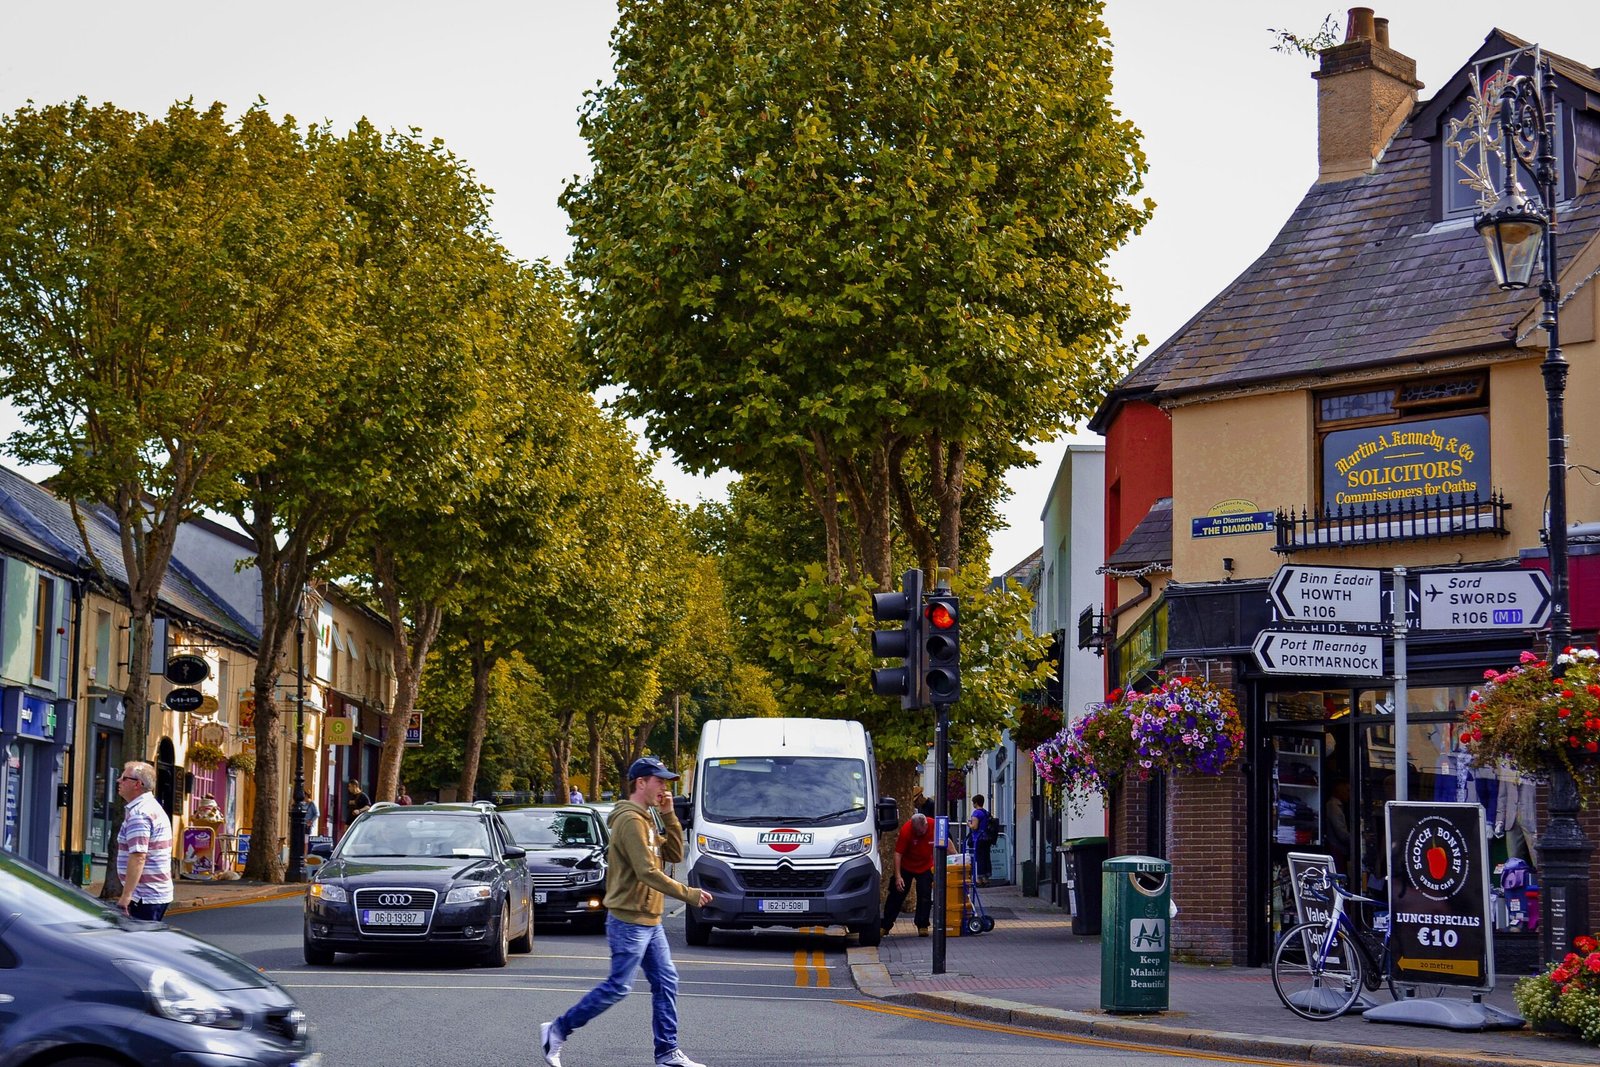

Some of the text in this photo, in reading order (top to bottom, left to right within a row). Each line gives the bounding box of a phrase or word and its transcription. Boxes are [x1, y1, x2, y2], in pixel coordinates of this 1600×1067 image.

[1335, 441, 1378, 476] Martin
[1391, 429, 1445, 453] Kennedy
[1445, 437, 1460, 454] &
[1458, 442, 1476, 463] Co.
[1348, 458, 1464, 488] SOLICITORS
[1335, 478, 1477, 505] Commissioners for Oaths
[1212, 515, 1254, 526] An Diamant
[1202, 526, 1221, 536] THE
[1222, 522, 1264, 534] DIAMOND
[1300, 570, 1374, 587] Binn Éadair
[1448, 577, 1482, 589] Sord
[1301, 588, 1352, 601] HOWTH
[1449, 592, 1518, 605] SWORDS
[1303, 605, 1336, 618] R106
[1452, 612, 1488, 624] R106
[1280, 638, 1367, 655] Port Mearnóg
[1281, 654, 1379, 670] PORTMARNOCK
[761, 833, 812, 843] ALLTRANS
[1413, 827, 1432, 870] SCOTCH
[1437, 826, 1461, 873] BONNET
[1136, 862, 1166, 872] LITTER
[1419, 875, 1440, 890] URBAN
[767, 901, 804, 910] 162-D-5081
[1396, 912, 1433, 925] LUNCH
[1433, 916, 1480, 927] SPECIALS
[1417, 926, 1459, 948] €10
[1140, 955, 1161, 966] Keep
[1420, 960, 1454, 970] 20 metres
[1130, 967, 1166, 977] Malahide
[1130, 979, 1166, 989] Beautiful
